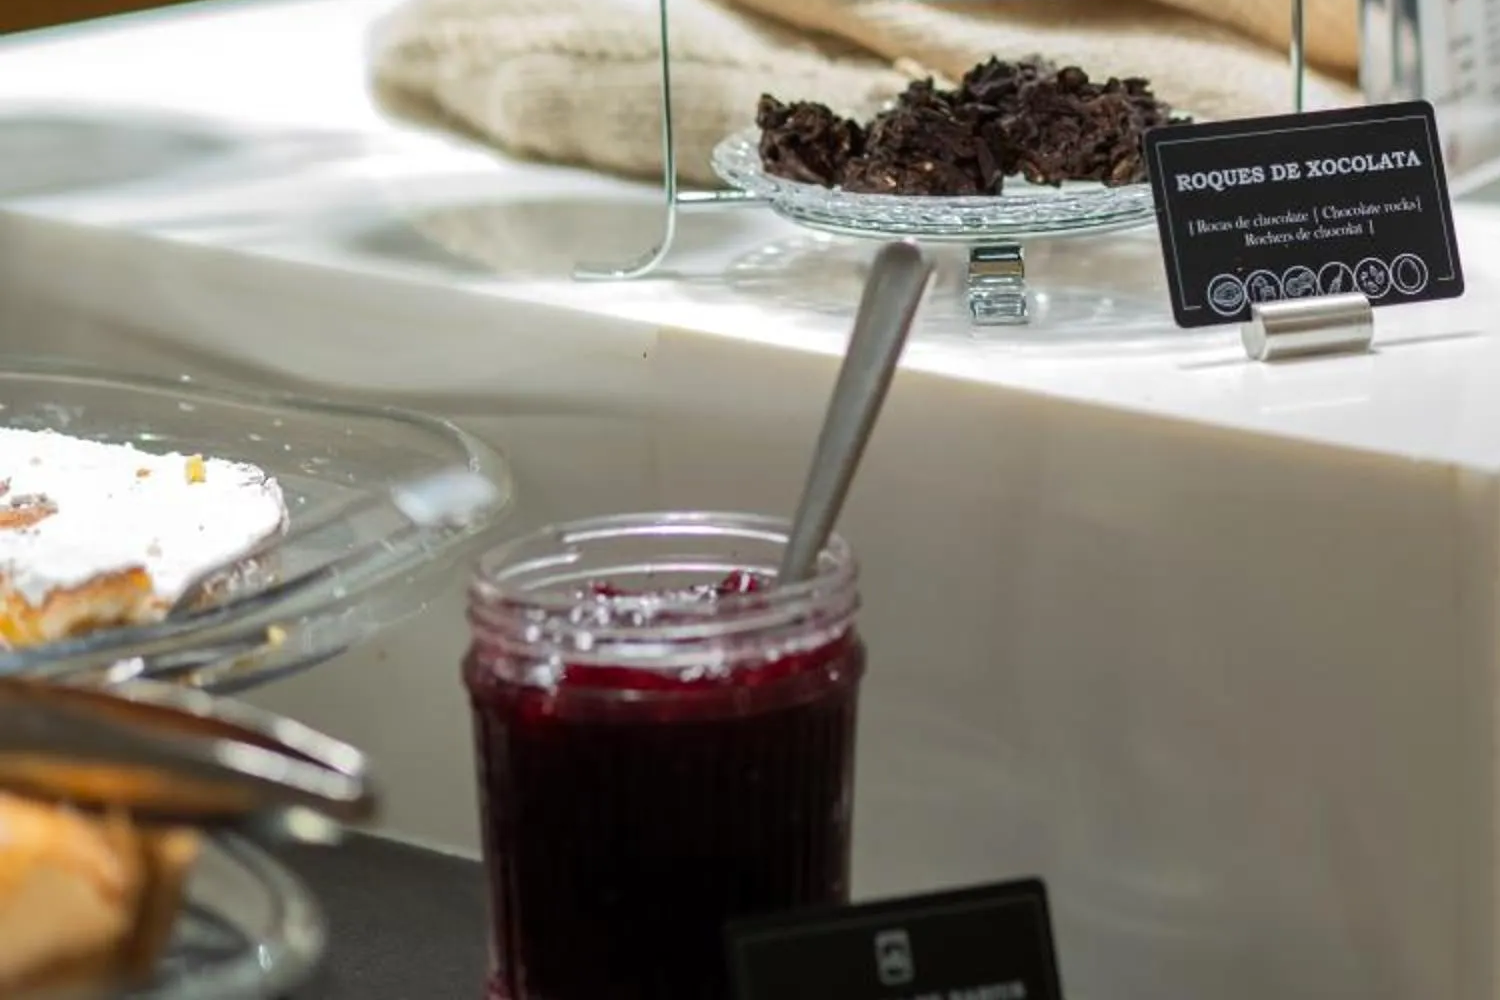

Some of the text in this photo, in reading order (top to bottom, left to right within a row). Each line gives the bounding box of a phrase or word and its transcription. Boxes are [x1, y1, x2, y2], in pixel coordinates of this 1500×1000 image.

[1175, 149, 1423, 192] ROQUES DE XOCOLATA
[1196, 218, 1233, 234] Rocas
[1234, 215, 1251, 229] de
[1252, 208, 1309, 227] chocolate
[1321, 201, 1381, 219] Chocolate
[1244, 230, 1294, 247] Rochers
[1295, 226, 1311, 241] de
[1313, 221, 1363, 239] chocolat
